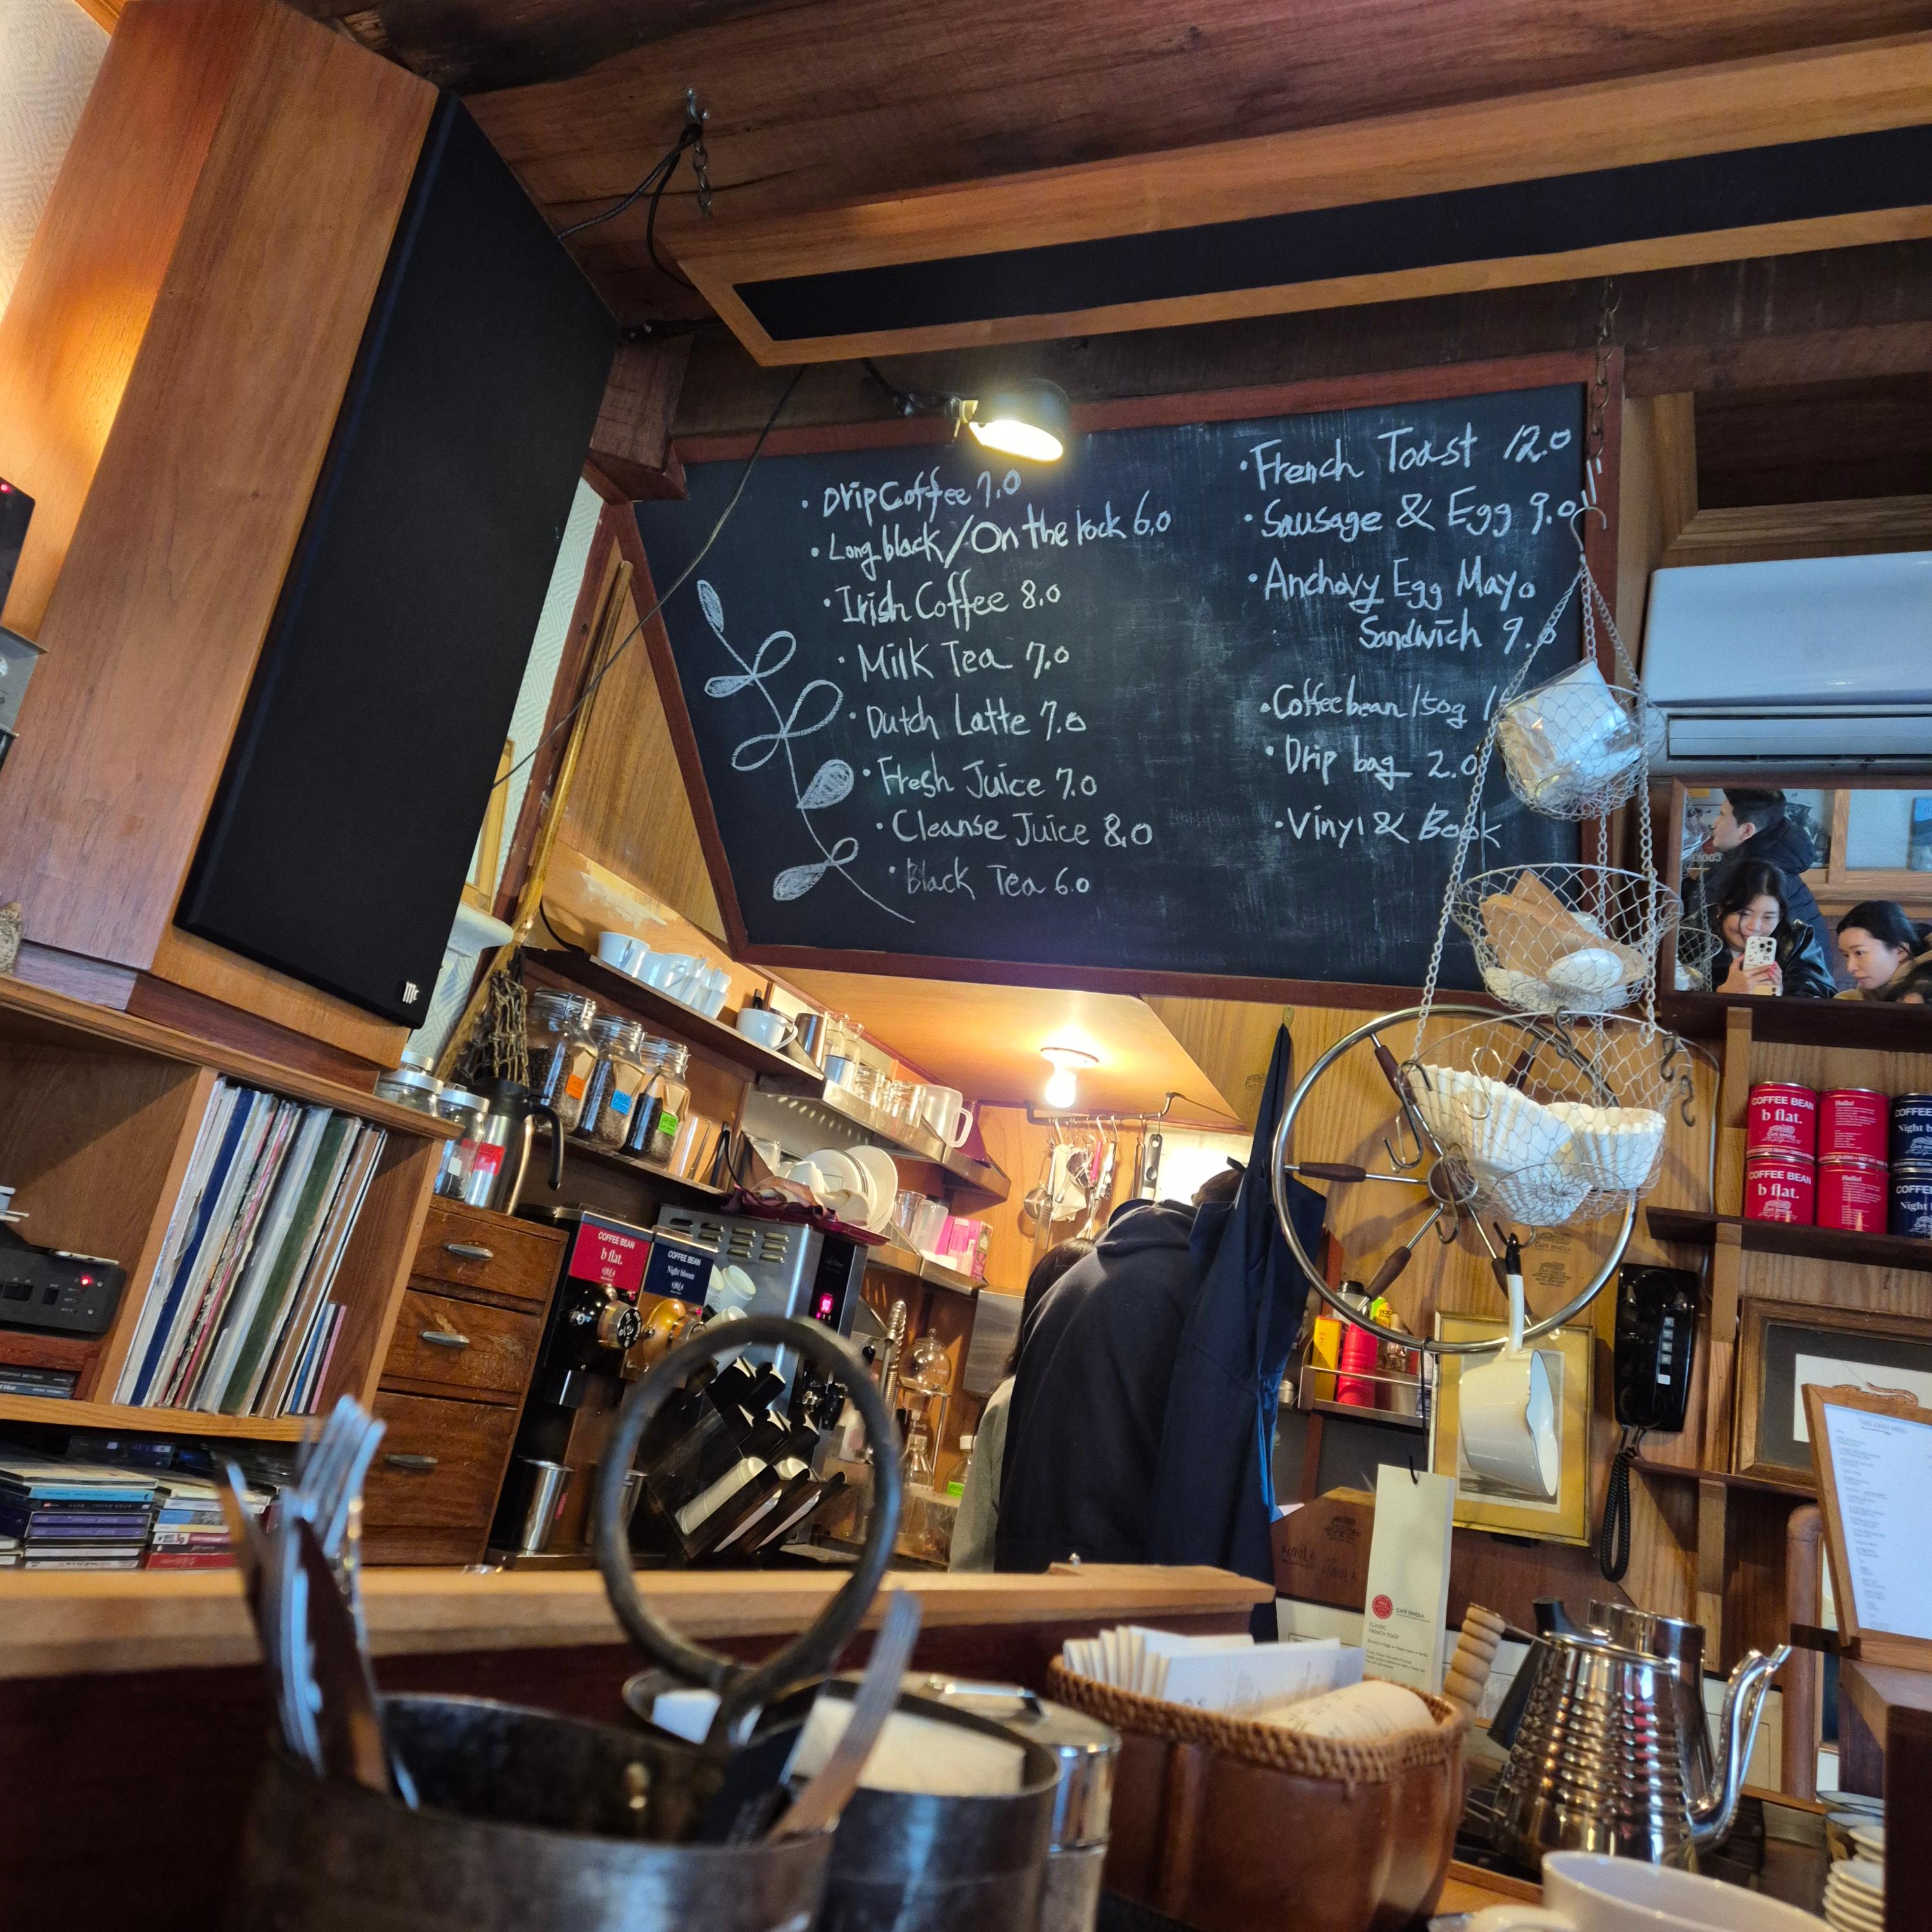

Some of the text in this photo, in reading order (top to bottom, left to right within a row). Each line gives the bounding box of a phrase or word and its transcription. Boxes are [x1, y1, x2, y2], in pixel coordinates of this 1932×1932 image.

[1249, 422, 1571, 490] French Toast 12.0
[977, 469, 1021, 508] 7.0
[1261, 486, 1576, 542] Sausage & Egg 9.0
[829, 533, 882, 581] Long
[1022, 504, 1068, 550] the
[836, 569, 1060, 631] Irish Coffee 8.0
[1393, 557, 1443, 611] Egg
[1457, 555, 1536, 612] Mayo
[1359, 608, 1483, 652] Sandwich
[858, 637, 1069, 682] Milk Tea 7.0
[867, 693, 1086, 741] Dutch Latte 7.0
[877, 752, 1097, 799] Fresh Juice 7.0
[1285, 734, 1478, 790] Drip bag 2.0
[892, 809, 1007, 842] Cleanse
[1012, 812, 1090, 847] Juice
[1373, 812, 1410, 843] &
[907, 858, 1090, 900] Black Tea 6.0
[1751, 1096, 1814, 1111] COFFEE BEAN
[1762, 1108, 1803, 1124] b flat.
[1895, 1107, 1932, 1118] COFFEE
[1898, 1124, 1923, 1134] Night
[1749, 1170, 1811, 1185] COFFEE BEAN
[1758, 1184, 1800, 1199] b flat.
[1900, 1201, 1927, 1212] Night
[598, 1231, 635, 1249] COFFEE BEAN
[601, 1248, 607, 1260] b
[668, 1250, 701, 1266] COFFEE BEAN
